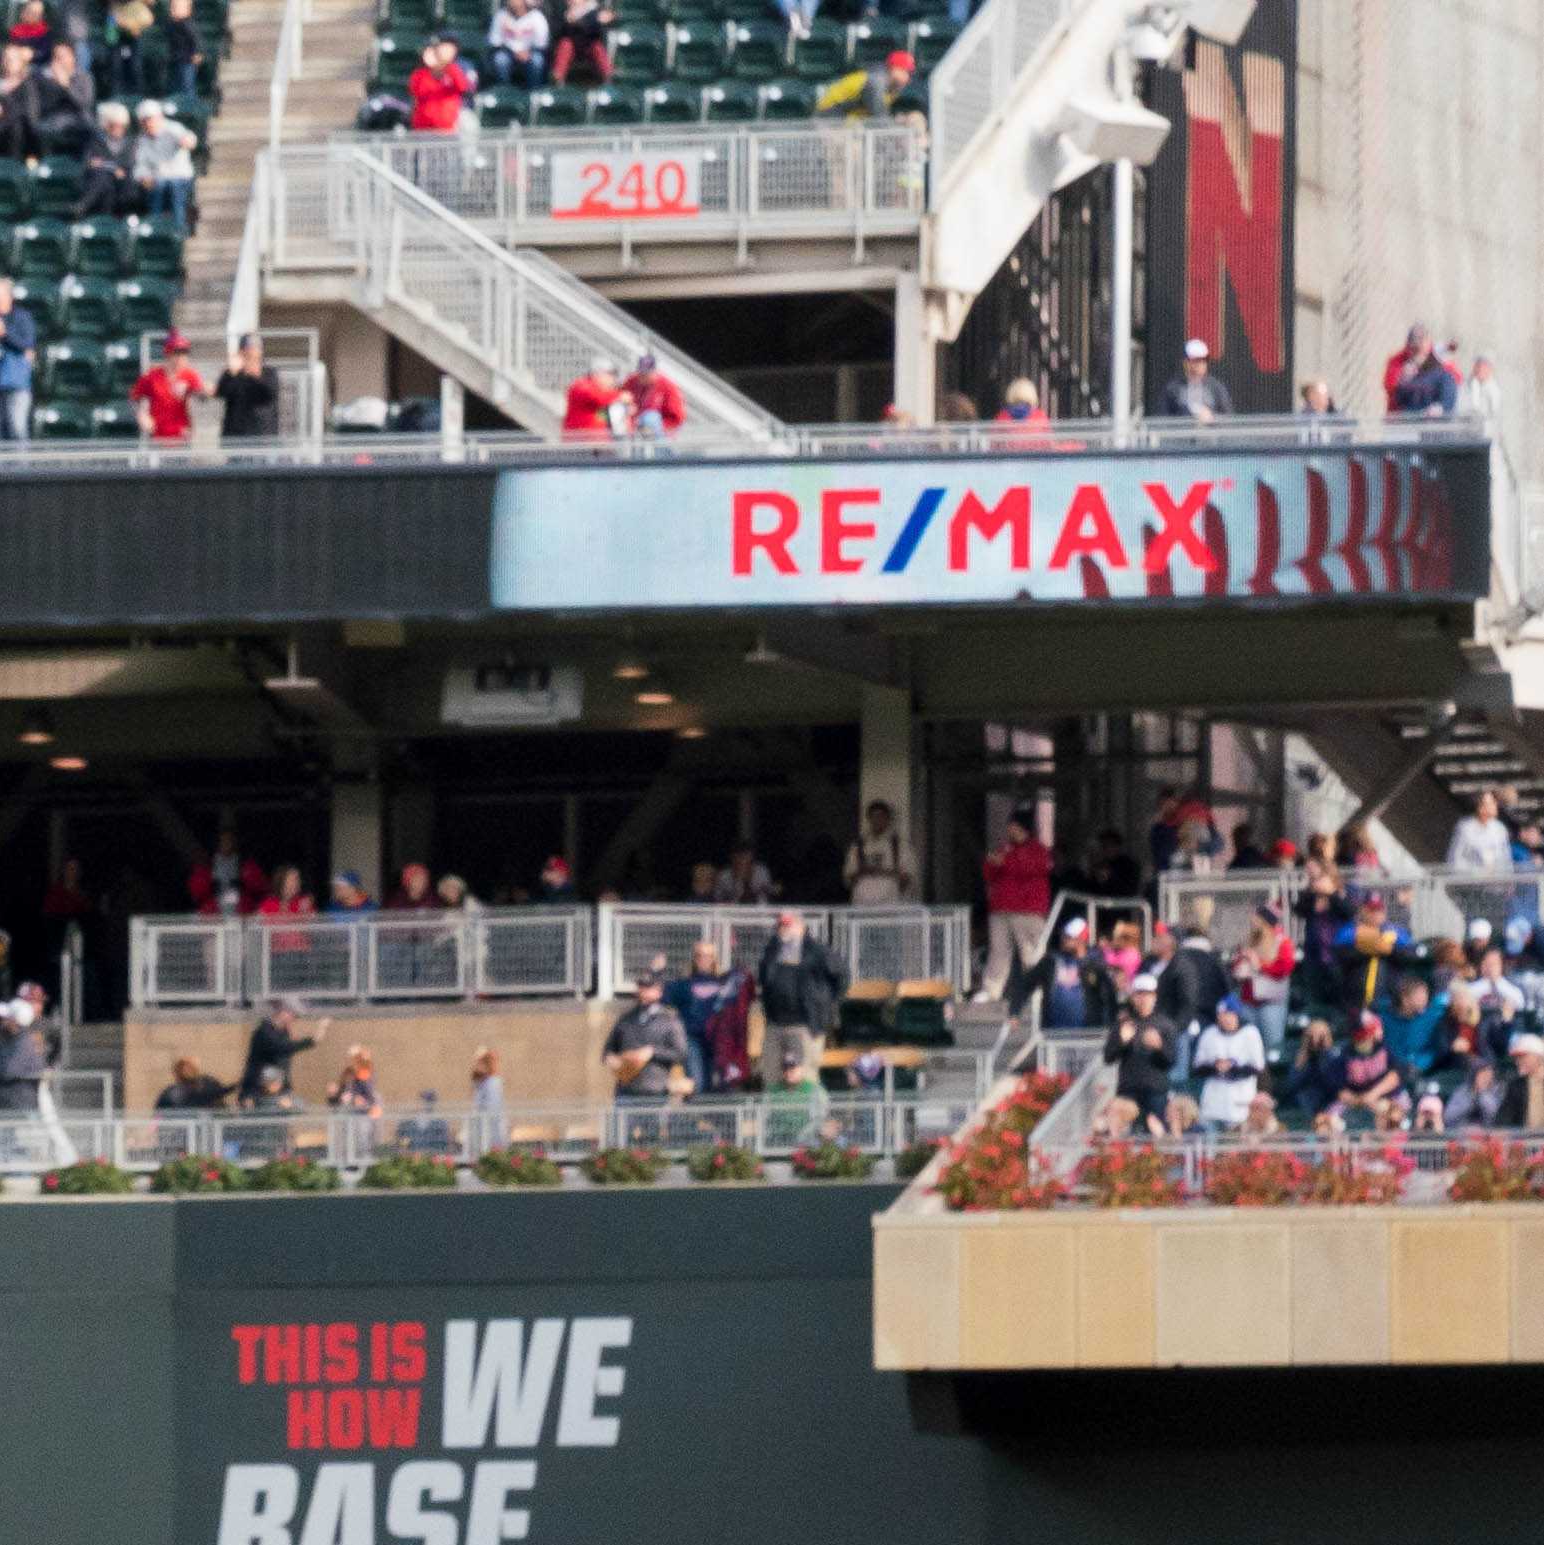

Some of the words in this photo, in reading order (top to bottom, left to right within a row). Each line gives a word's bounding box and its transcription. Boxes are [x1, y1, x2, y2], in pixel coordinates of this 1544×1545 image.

[579, 160, 687, 215] 240
[731, 481, 1219, 576] RE/MAX
[231, 1323, 360, 1385] THIS
[370, 1321, 427, 1383] IS
[441, 1316, 633, 1449] WE
[286, 1389, 422, 1450] HOW
